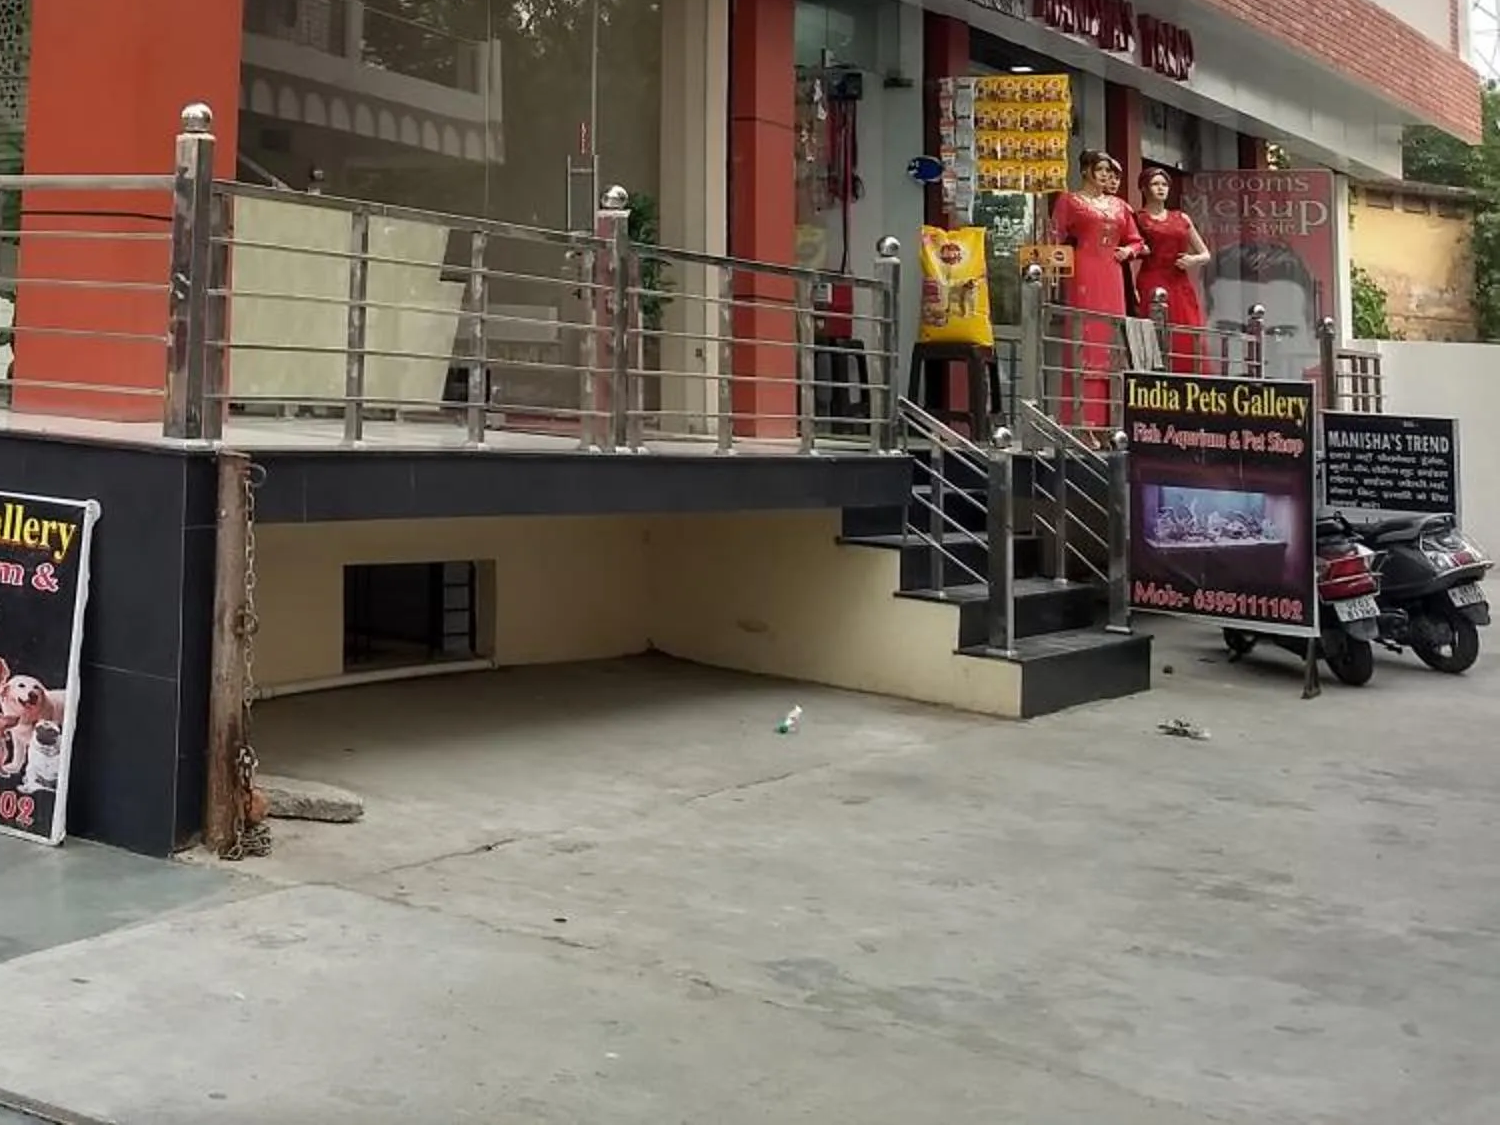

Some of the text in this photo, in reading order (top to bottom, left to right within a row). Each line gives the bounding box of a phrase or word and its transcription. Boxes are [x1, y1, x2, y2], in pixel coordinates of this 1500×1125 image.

[1127, 378, 1309, 427] India Pets Gallery
[1132, 422, 1163, 445] Fish
[1229, 430, 1242, 451] &
[1243, 430, 1266, 452] Pet
[1267, 431, 1305, 456] Shop
[1328, 430, 1449, 453] MANISHA'S TREND
[31, 562, 60, 594] &
